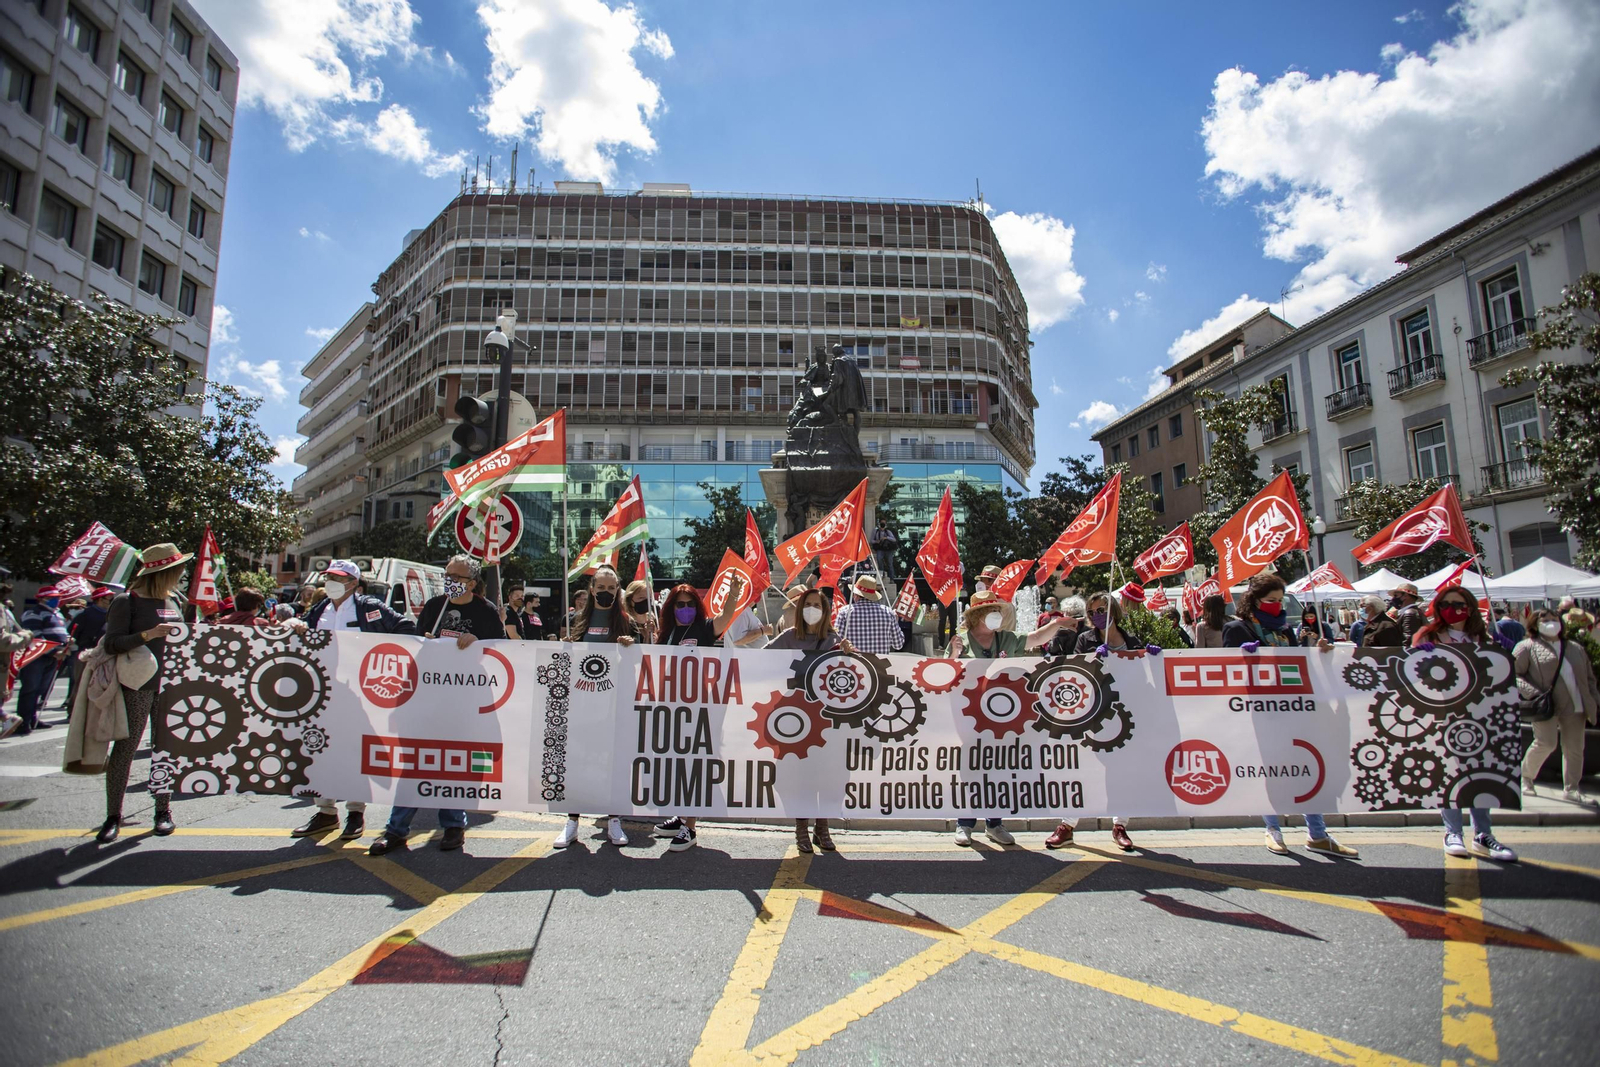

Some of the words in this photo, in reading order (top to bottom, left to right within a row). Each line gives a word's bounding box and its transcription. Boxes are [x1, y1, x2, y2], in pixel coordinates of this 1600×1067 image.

[366, 653, 411, 681] UGT
[422, 671, 499, 687] GRANADA
[634, 654, 744, 705] AHORA
[1173, 664, 1278, 687] CCOO
[574, 678, 595, 692] MAYO
[596, 678, 614, 692] 2021
[1228, 696, 1316, 712] Granada
[634, 705, 713, 755] TOCA
[369, 744, 468, 773] CCOO
[845, 738, 874, 771] Un
[881, 738, 929, 776] país
[936, 745, 961, 771] en
[969, 737, 1033, 771] deuda
[1040, 743, 1079, 770] con
[1173, 750, 1221, 776] UGT
[631, 756, 777, 808] CUMPLIR
[1235, 764, 1312, 779] GRANADA
[417, 781, 502, 800] Granada
[844, 781, 871, 809] su
[879, 774, 943, 816] gente
[950, 773, 1084, 815] trabajadora
